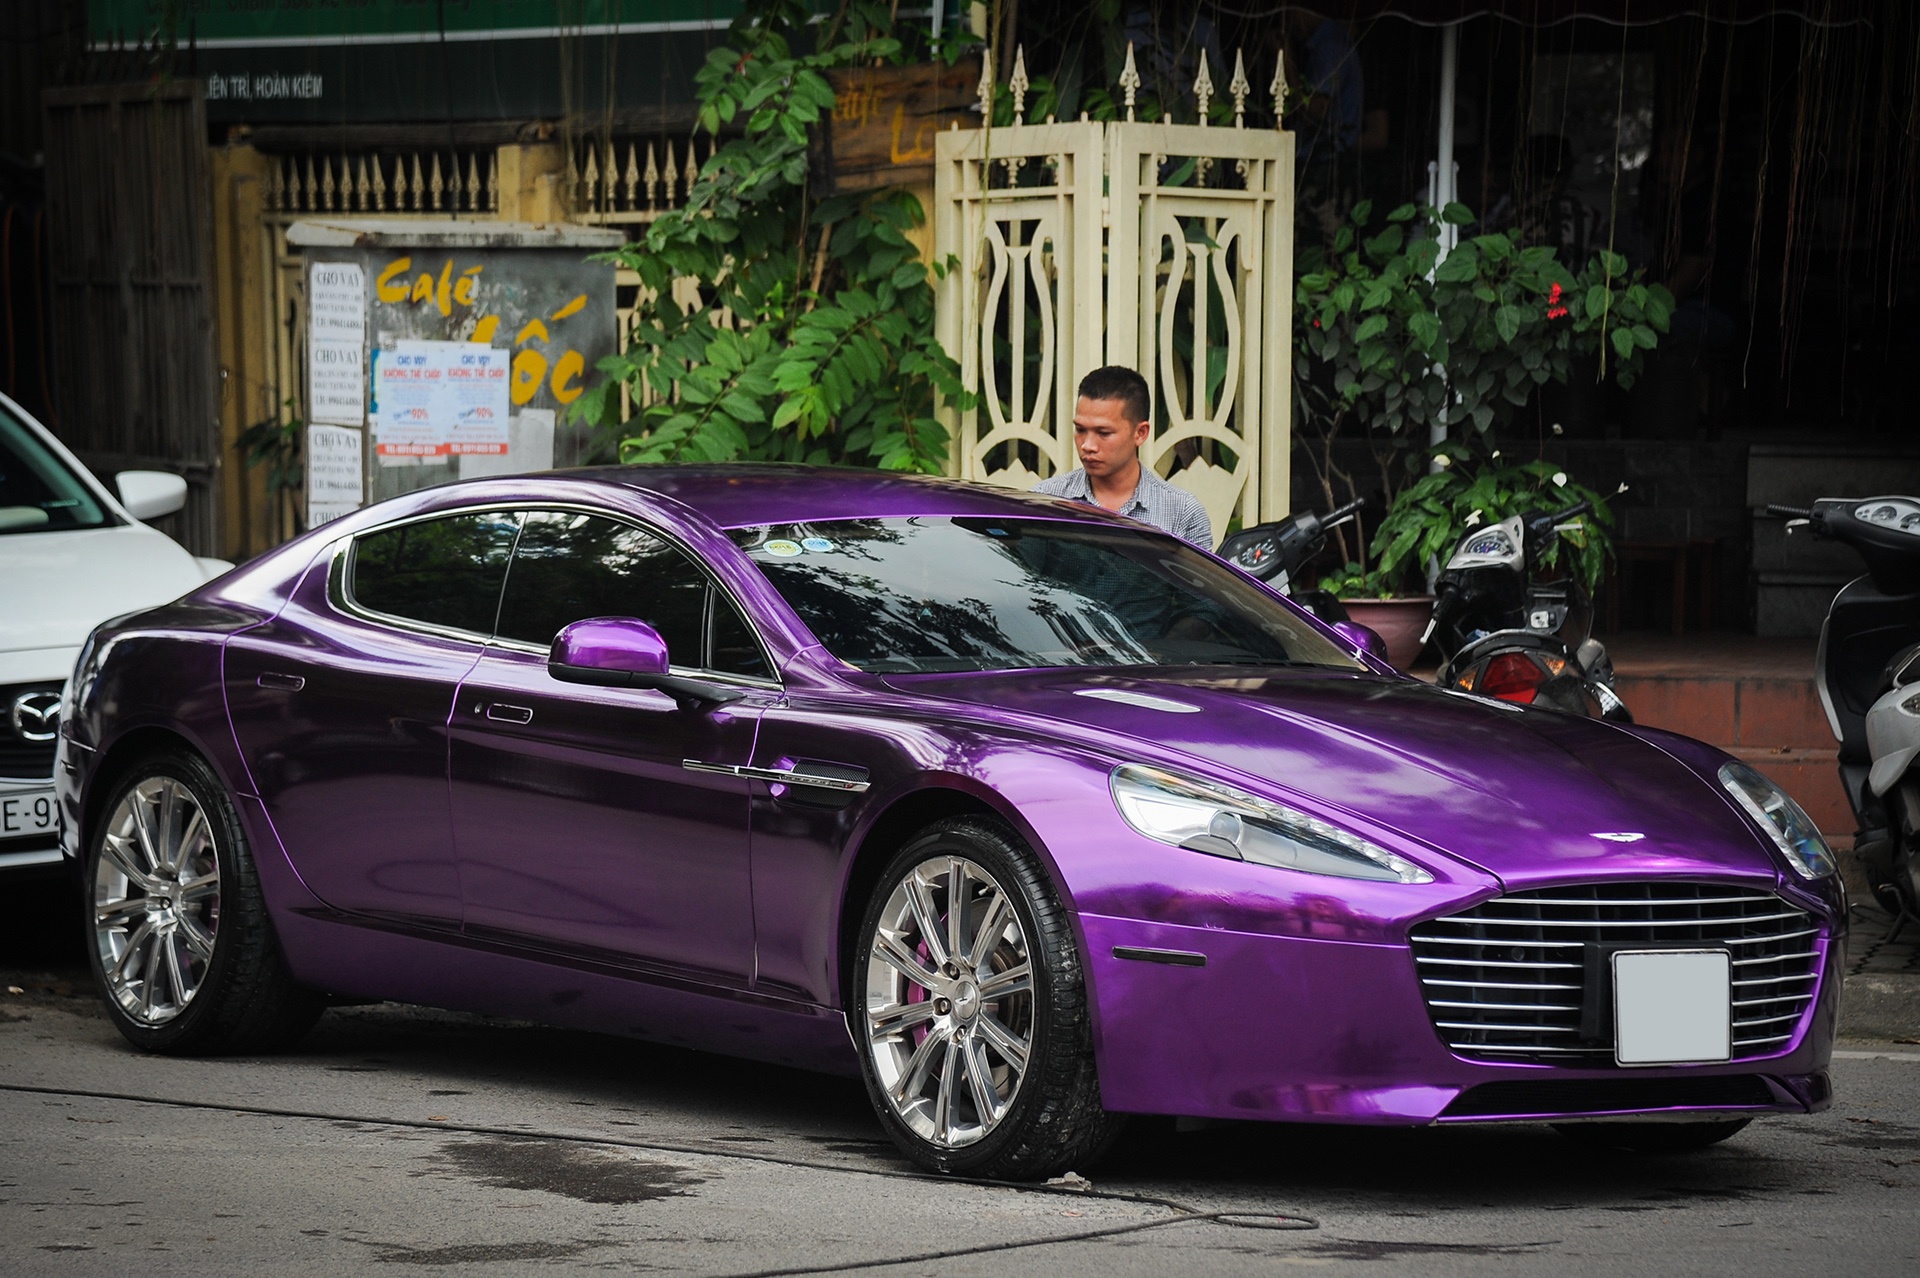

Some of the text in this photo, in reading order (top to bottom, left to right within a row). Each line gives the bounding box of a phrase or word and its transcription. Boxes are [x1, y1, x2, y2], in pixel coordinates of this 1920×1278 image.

[206, 71, 229, 100] IÊN
[315, 349, 358, 366] CHO VAY
[314, 433, 358, 450] CHO VAY
[3, 797, 60, 832] E-9
